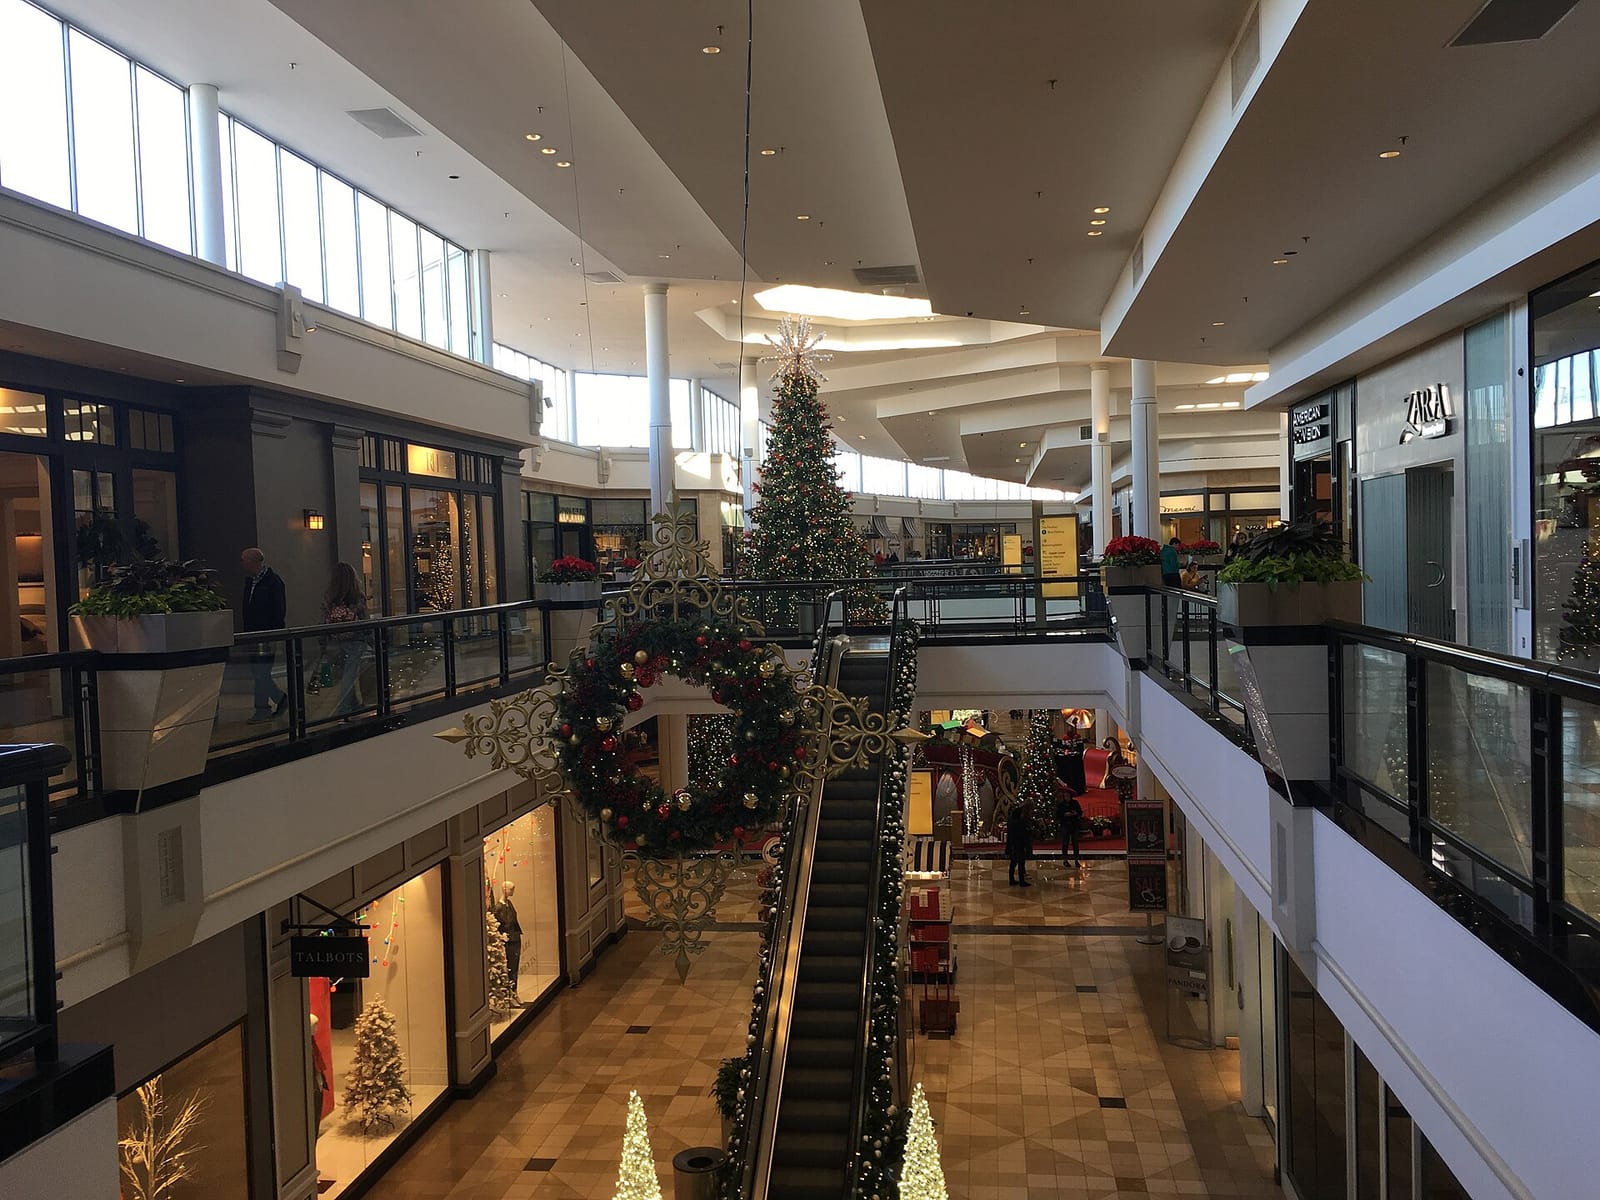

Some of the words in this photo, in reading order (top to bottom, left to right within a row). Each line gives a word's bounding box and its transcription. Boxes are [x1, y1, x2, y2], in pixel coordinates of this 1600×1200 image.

[1400, 382, 1452, 445] ZARA
[1133, 820, 1158, 834] SALE
[1136, 877, 1161, 891] SALE
[296, 951, 364, 963] TALBOTS
[1168, 976, 1207, 991] PANDORA
